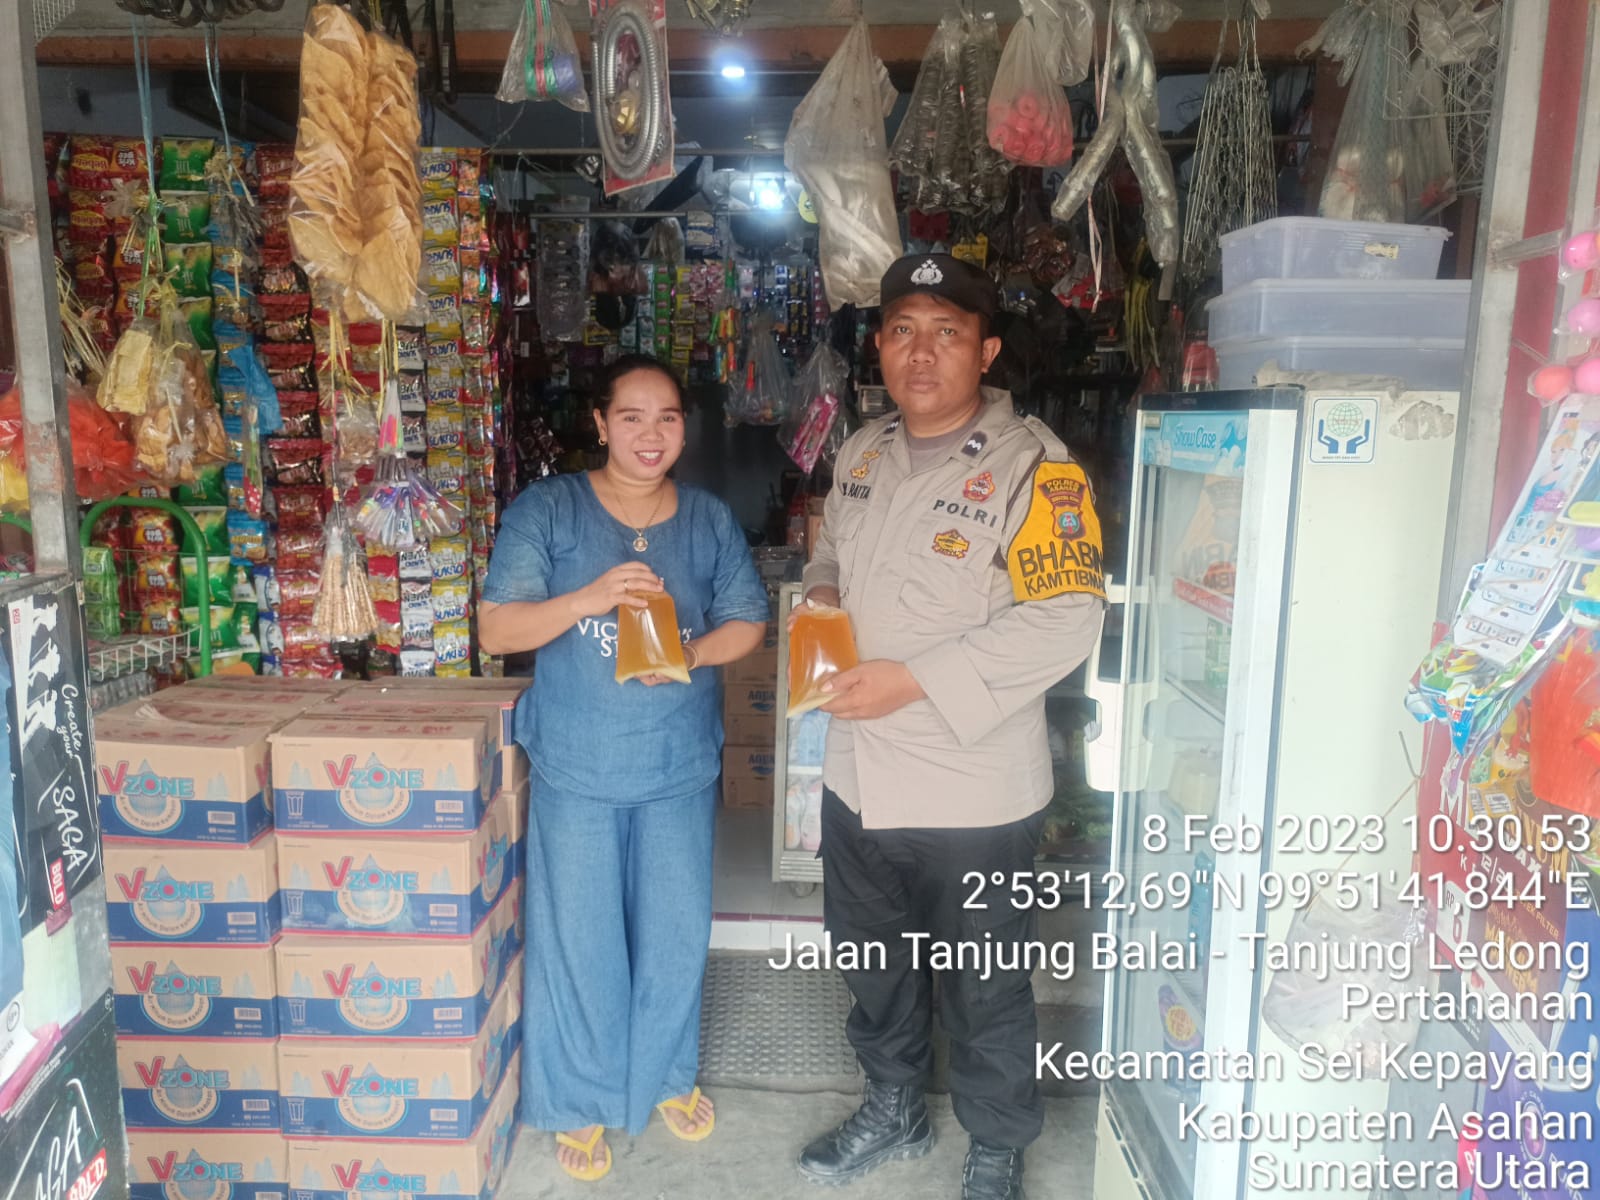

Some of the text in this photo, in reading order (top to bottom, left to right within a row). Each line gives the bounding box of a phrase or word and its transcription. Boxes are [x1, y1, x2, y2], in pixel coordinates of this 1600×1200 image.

[932, 499, 998, 529] POLRI
[61, 683, 83, 752] Create
[52, 785, 88, 873] SAGA
[50, 861, 65, 907] BOLD
